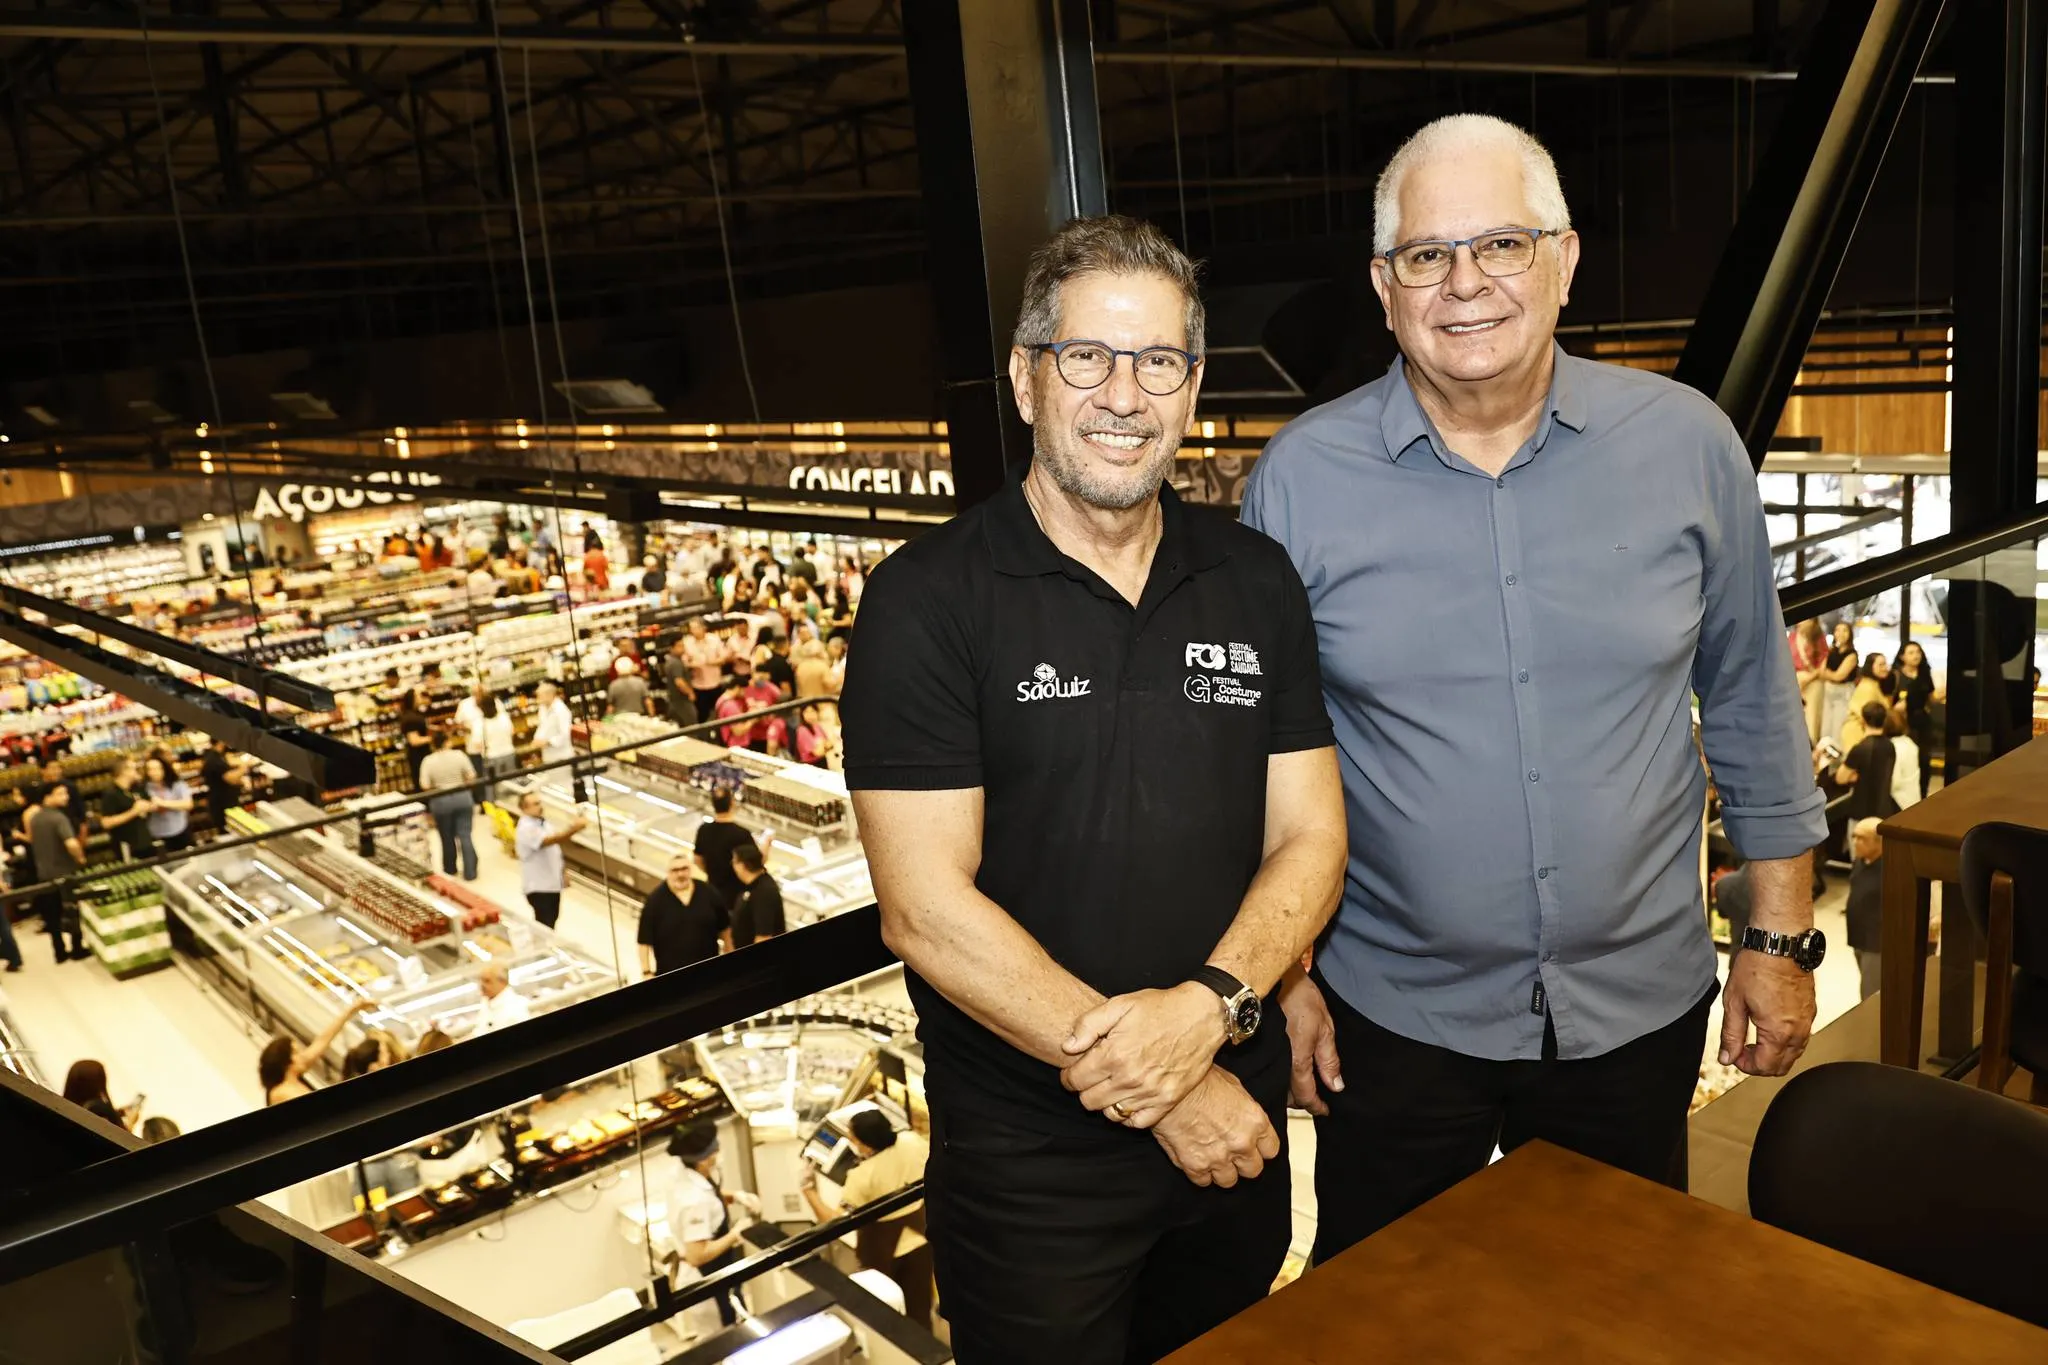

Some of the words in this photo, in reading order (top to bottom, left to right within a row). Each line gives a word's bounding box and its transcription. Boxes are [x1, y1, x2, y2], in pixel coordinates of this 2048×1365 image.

[1212, 676, 1242, 687] FESTIVAL
[1219, 684, 1262, 699] Costume
[1213, 692, 1258, 707] Gourmet
